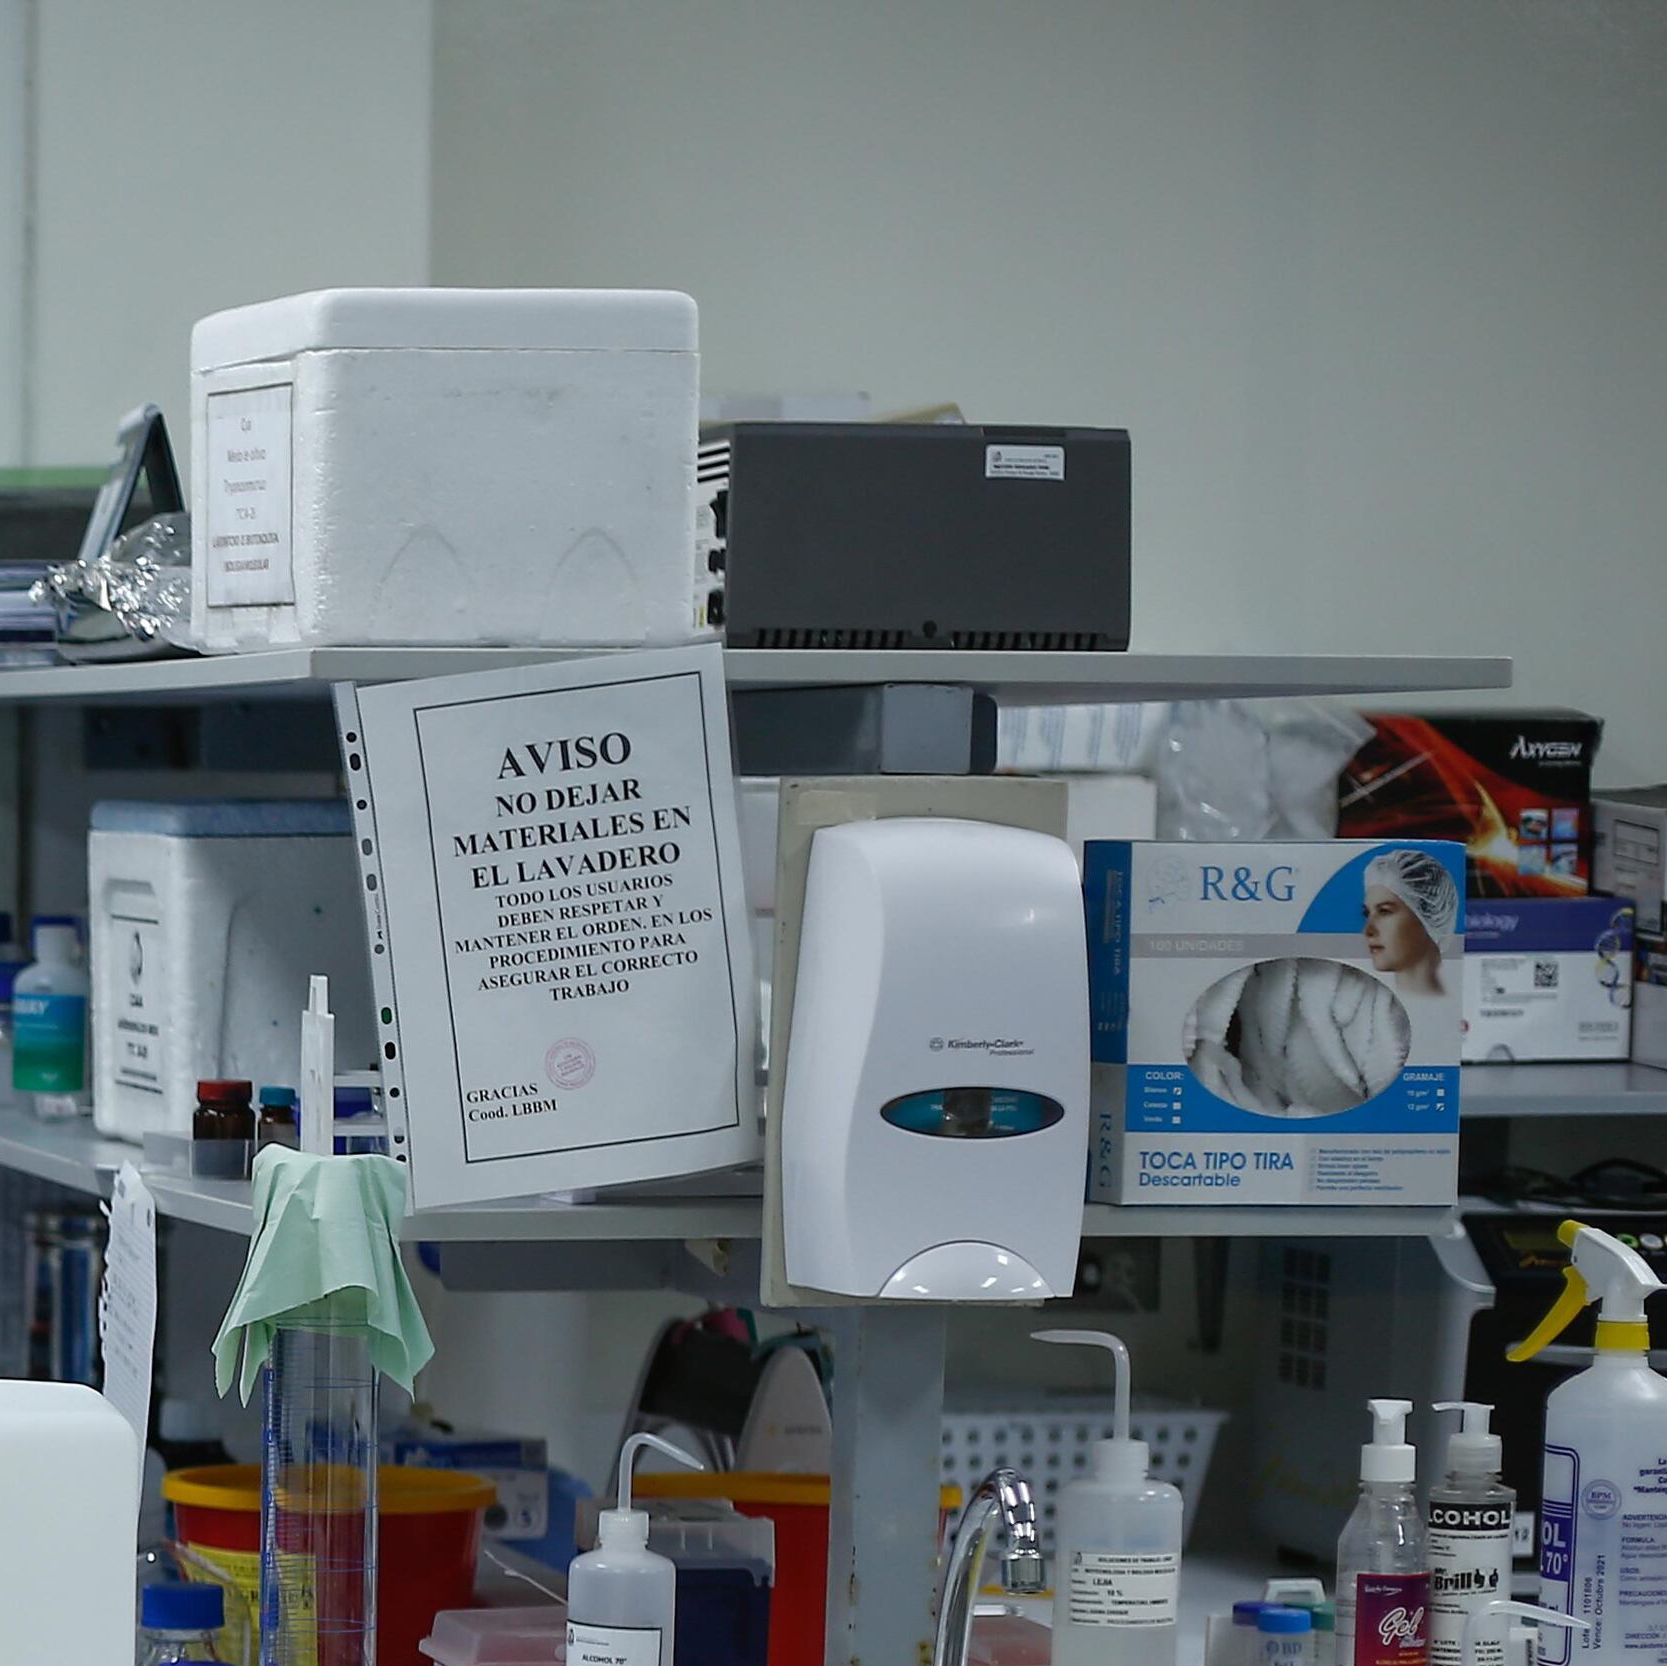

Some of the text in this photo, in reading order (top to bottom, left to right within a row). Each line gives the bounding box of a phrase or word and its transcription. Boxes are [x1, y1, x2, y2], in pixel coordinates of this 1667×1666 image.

[497, 732, 631, 780] AVISO
[496, 778, 643, 817] NO DEJAR
[453, 805, 692, 857] MATERIALES EN
[471, 841, 681, 889] EL LAVADERO
[495, 873, 674, 908] TODO LOS USUARIOS
[1199, 866, 1296, 901] R&G
[498, 894, 664, 928] DEBEN RESPETAR Y
[455, 929, 552, 954] MANTENER
[556, 925, 578, 942] EL
[651, 912, 674, 929] EN
[679, 907, 713, 924] LOS
[1175, 940, 1244, 951] UNIDADES
[489, 931, 687, 970] PROCEDIMIENTO PARA
[477, 949, 699, 991] ASEGURAR EL CORRECTO
[549, 978, 630, 1002] TRABAJO
[466, 1083, 538, 1104] GRACIAS
[468, 1099, 557, 1122] Cood. LBBM
[1139, 1152, 1294, 1171] TOCA TIPO TIRA
[1139, 1172, 1241, 1187] Descartable
[1546, 1551, 1569, 1575] 70°
[1379, 1606, 1424, 1645] Gel
[582, 1654, 613, 1665] ALCOHOL
